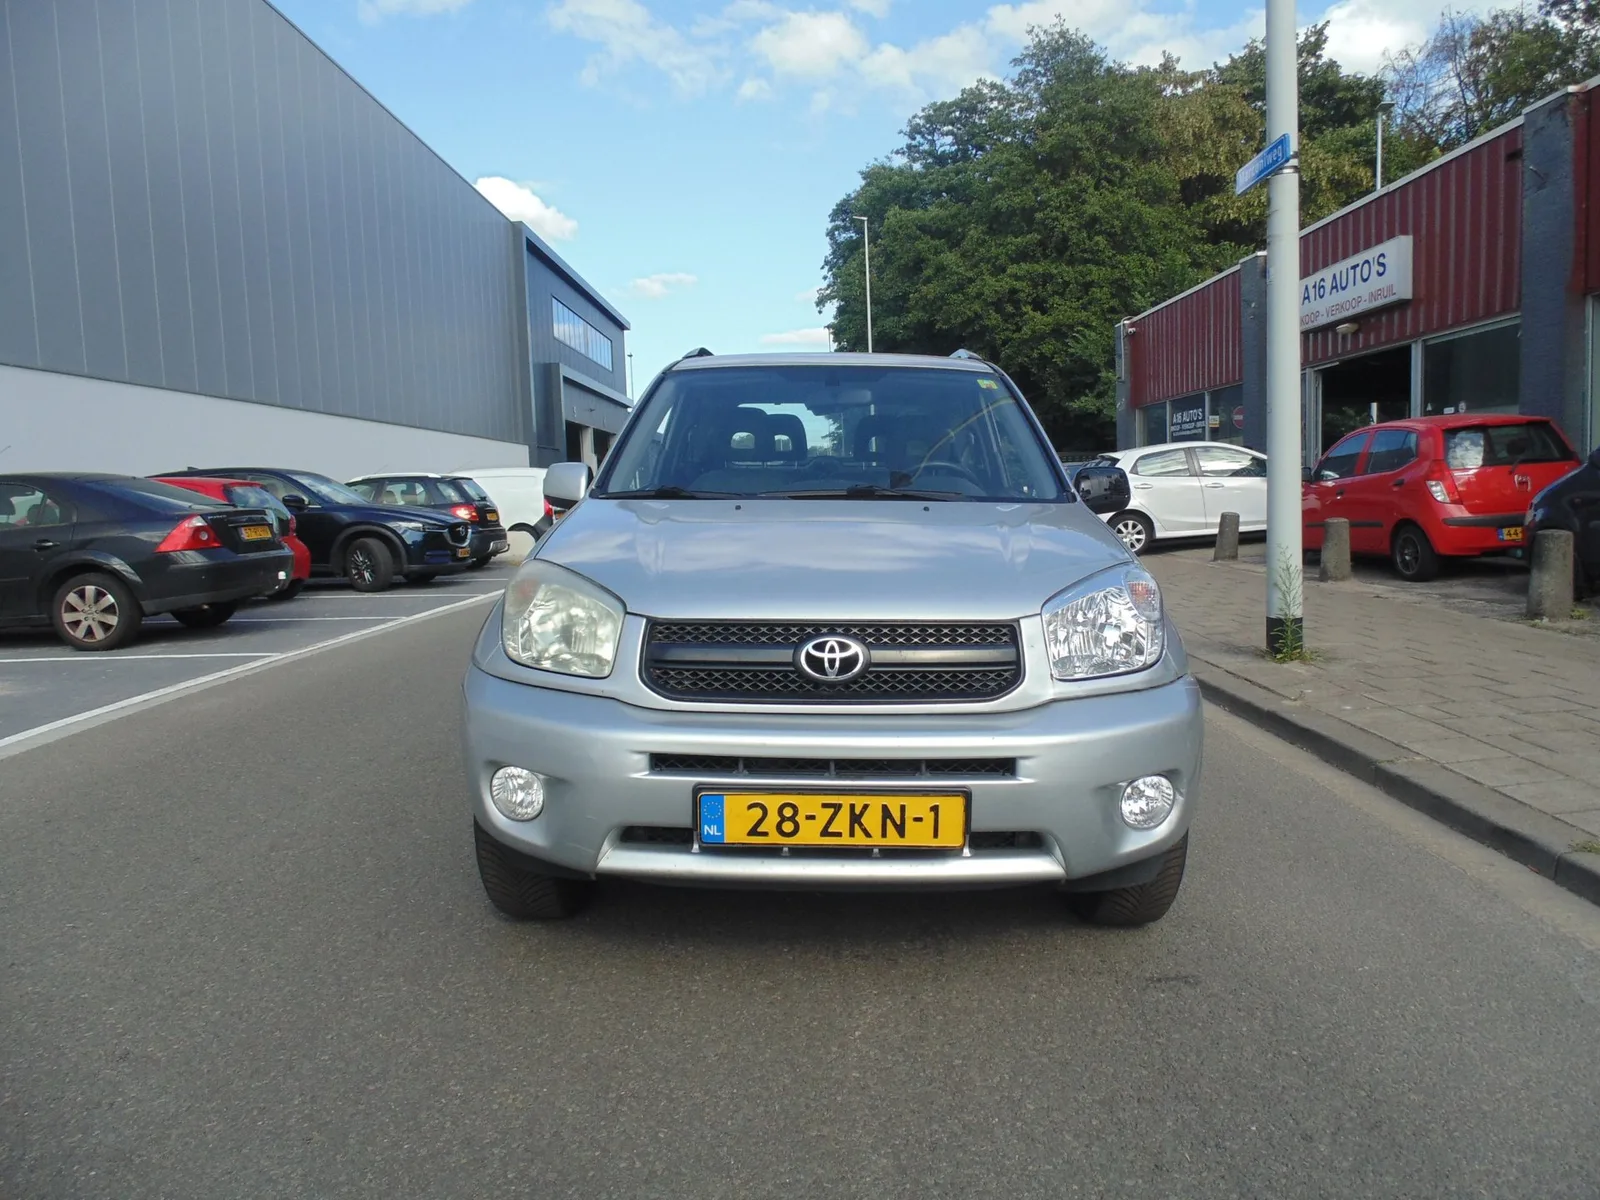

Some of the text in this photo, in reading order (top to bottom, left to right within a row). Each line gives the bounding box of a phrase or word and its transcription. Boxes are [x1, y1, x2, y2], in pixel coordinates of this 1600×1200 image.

[1302, 253, 1387, 306] A16 AUTO'S
[1325, 296, 1363, 318] VERKOOP
[1368, 284, 1397, 304] INRUIL
[703, 824, 722, 837] NL
[746, 801, 940, 840] 28-ZKN-1
